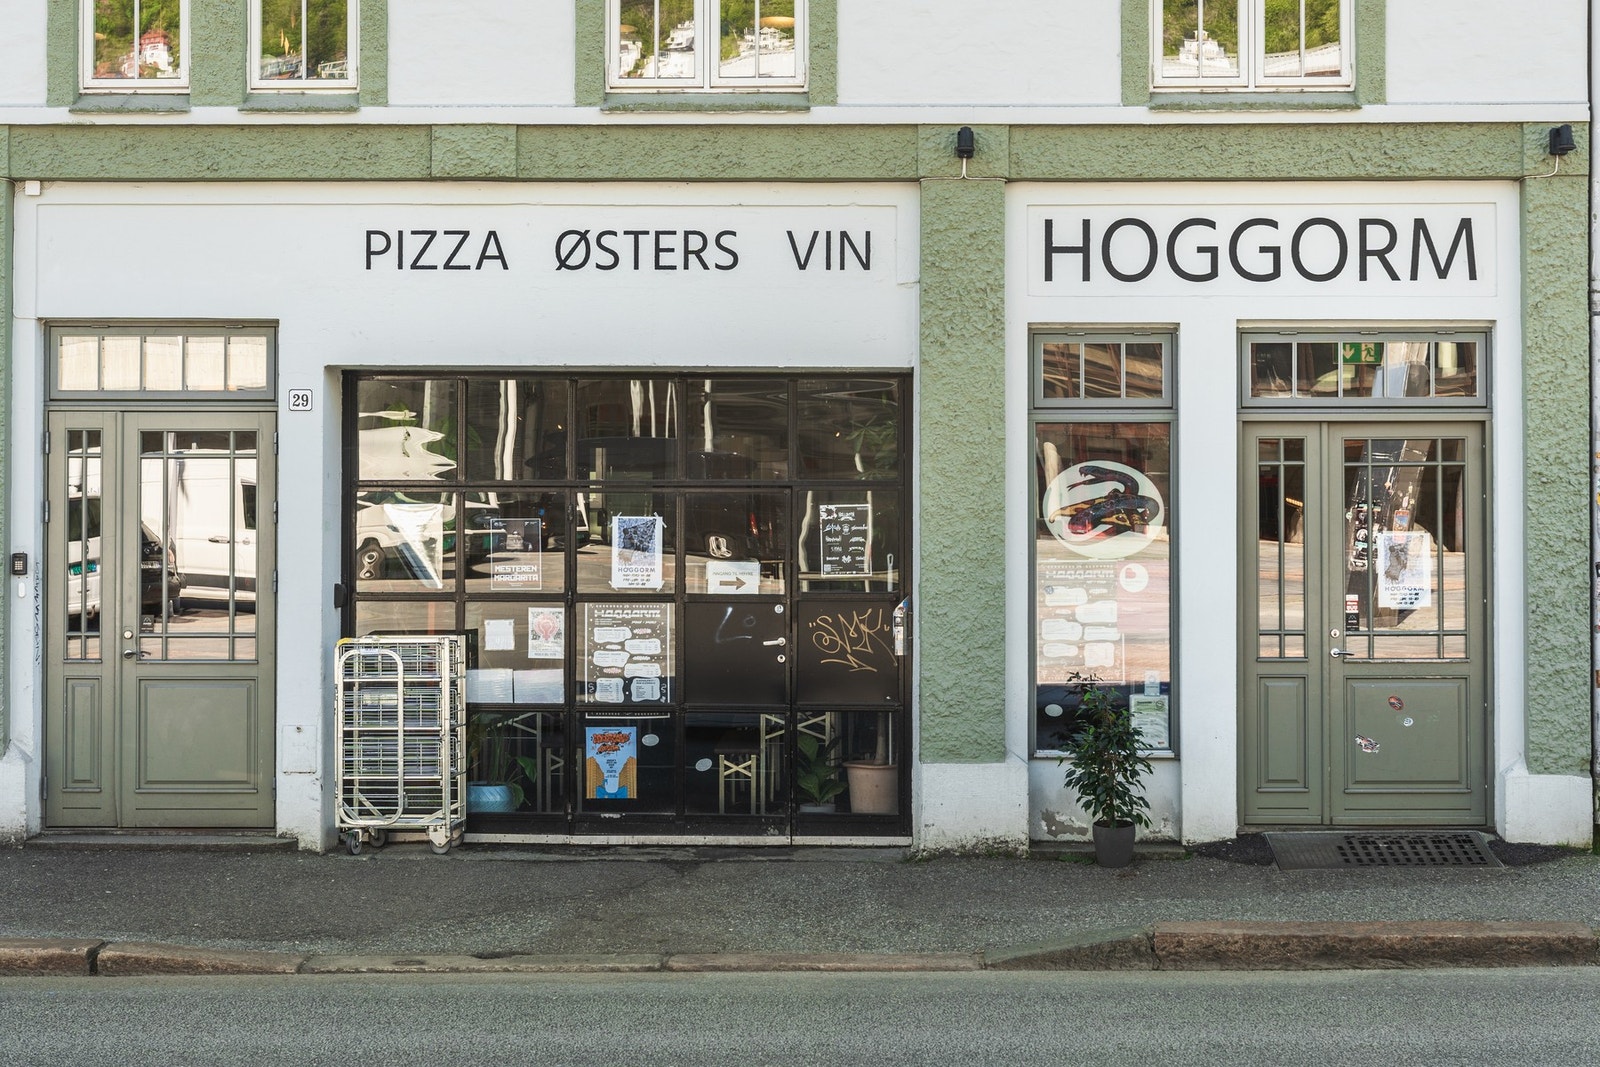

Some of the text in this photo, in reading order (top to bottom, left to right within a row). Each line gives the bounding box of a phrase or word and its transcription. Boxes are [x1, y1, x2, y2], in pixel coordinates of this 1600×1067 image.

[366, 228, 872, 273] PIZZA ØSTERS VIN
[1044, 217, 1479, 283] HOGGORM
[292, 393, 309, 409] 29
